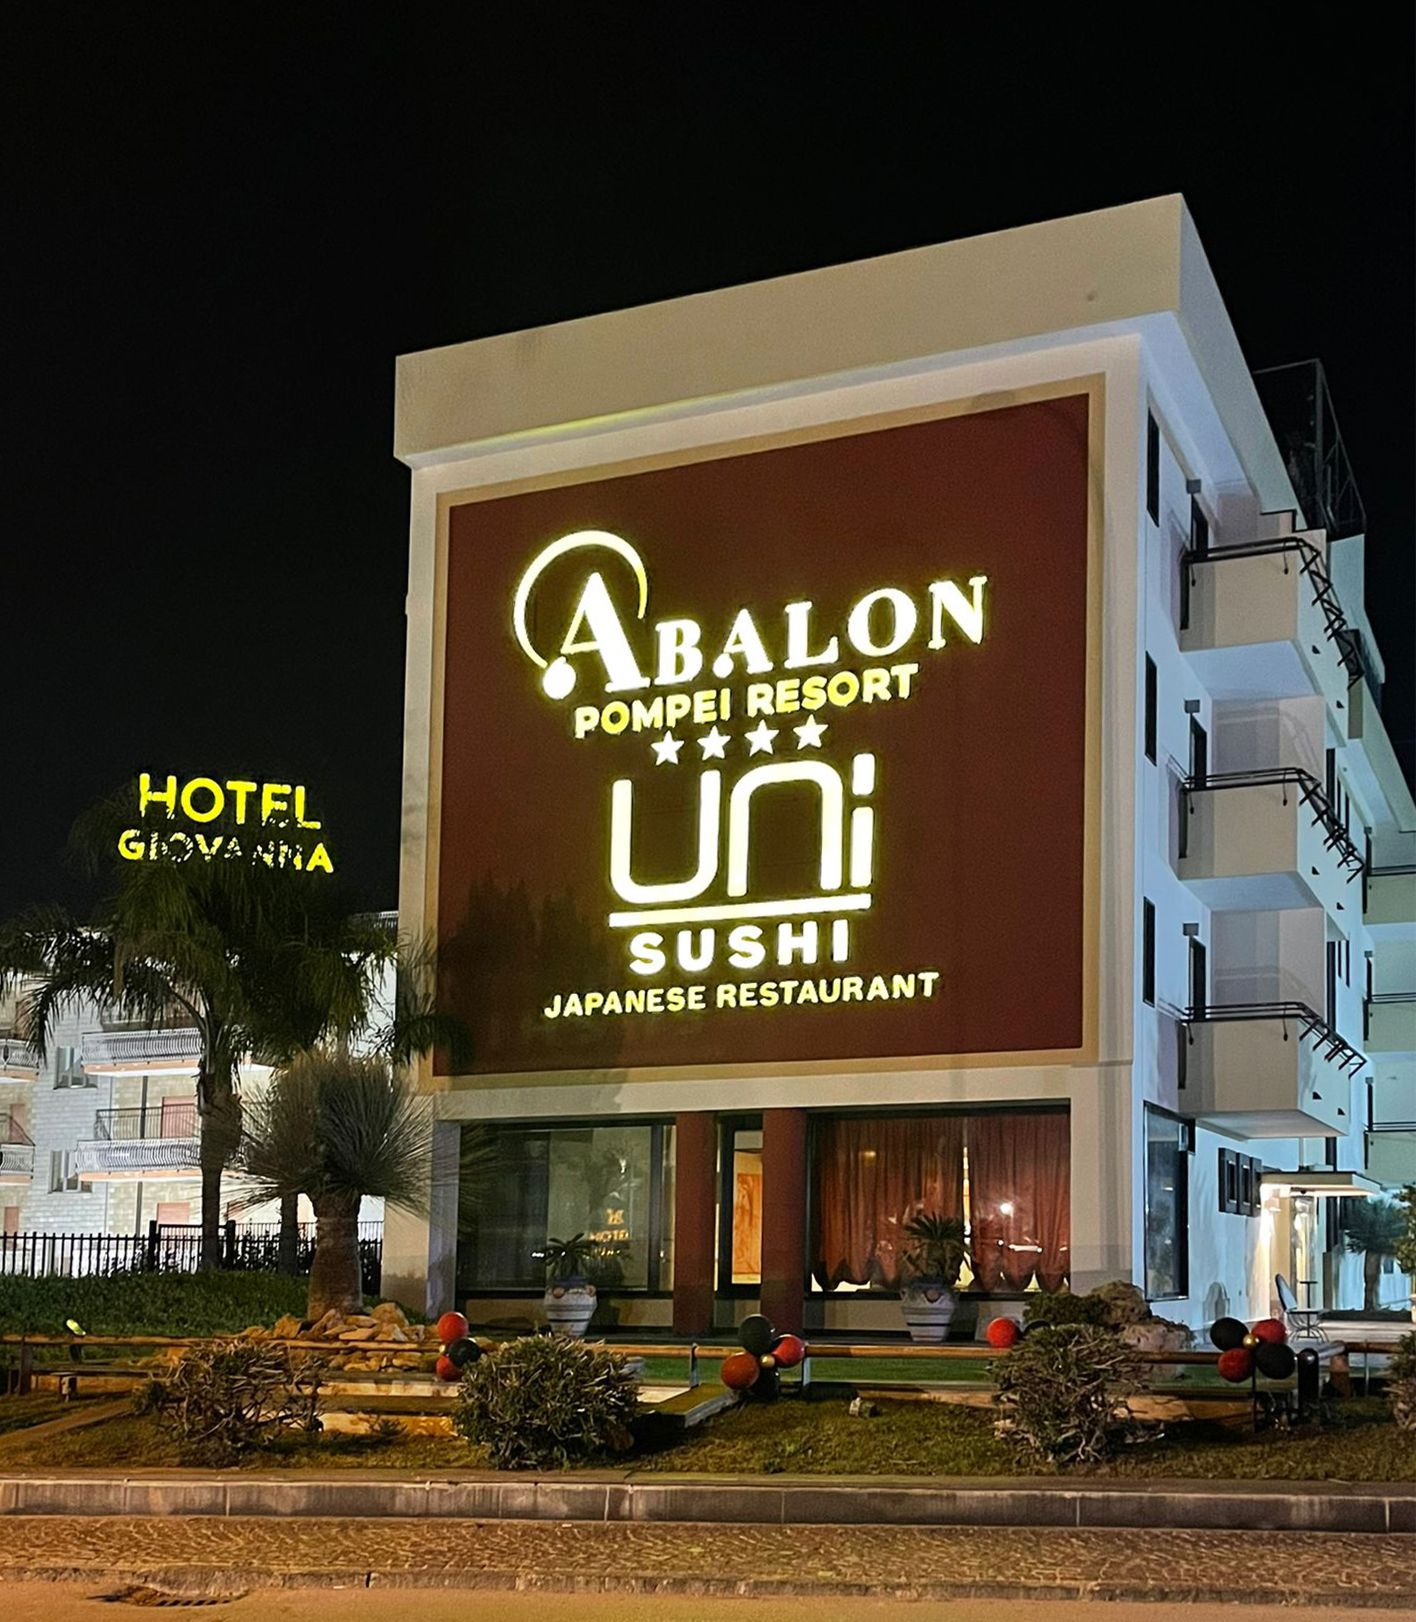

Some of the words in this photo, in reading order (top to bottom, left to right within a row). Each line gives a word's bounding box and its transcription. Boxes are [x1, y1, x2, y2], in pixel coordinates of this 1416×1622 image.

[514, 531, 988, 700] ABALON
[574, 688, 732, 739] POMPEI
[747, 663, 919, 718] RESORT
[138, 772, 322, 830] HOTEL
[628, 918, 850, 976] SUSHI
[543, 984, 707, 1019] JAPANESE
[715, 971, 941, 1010] RESTAURANT
